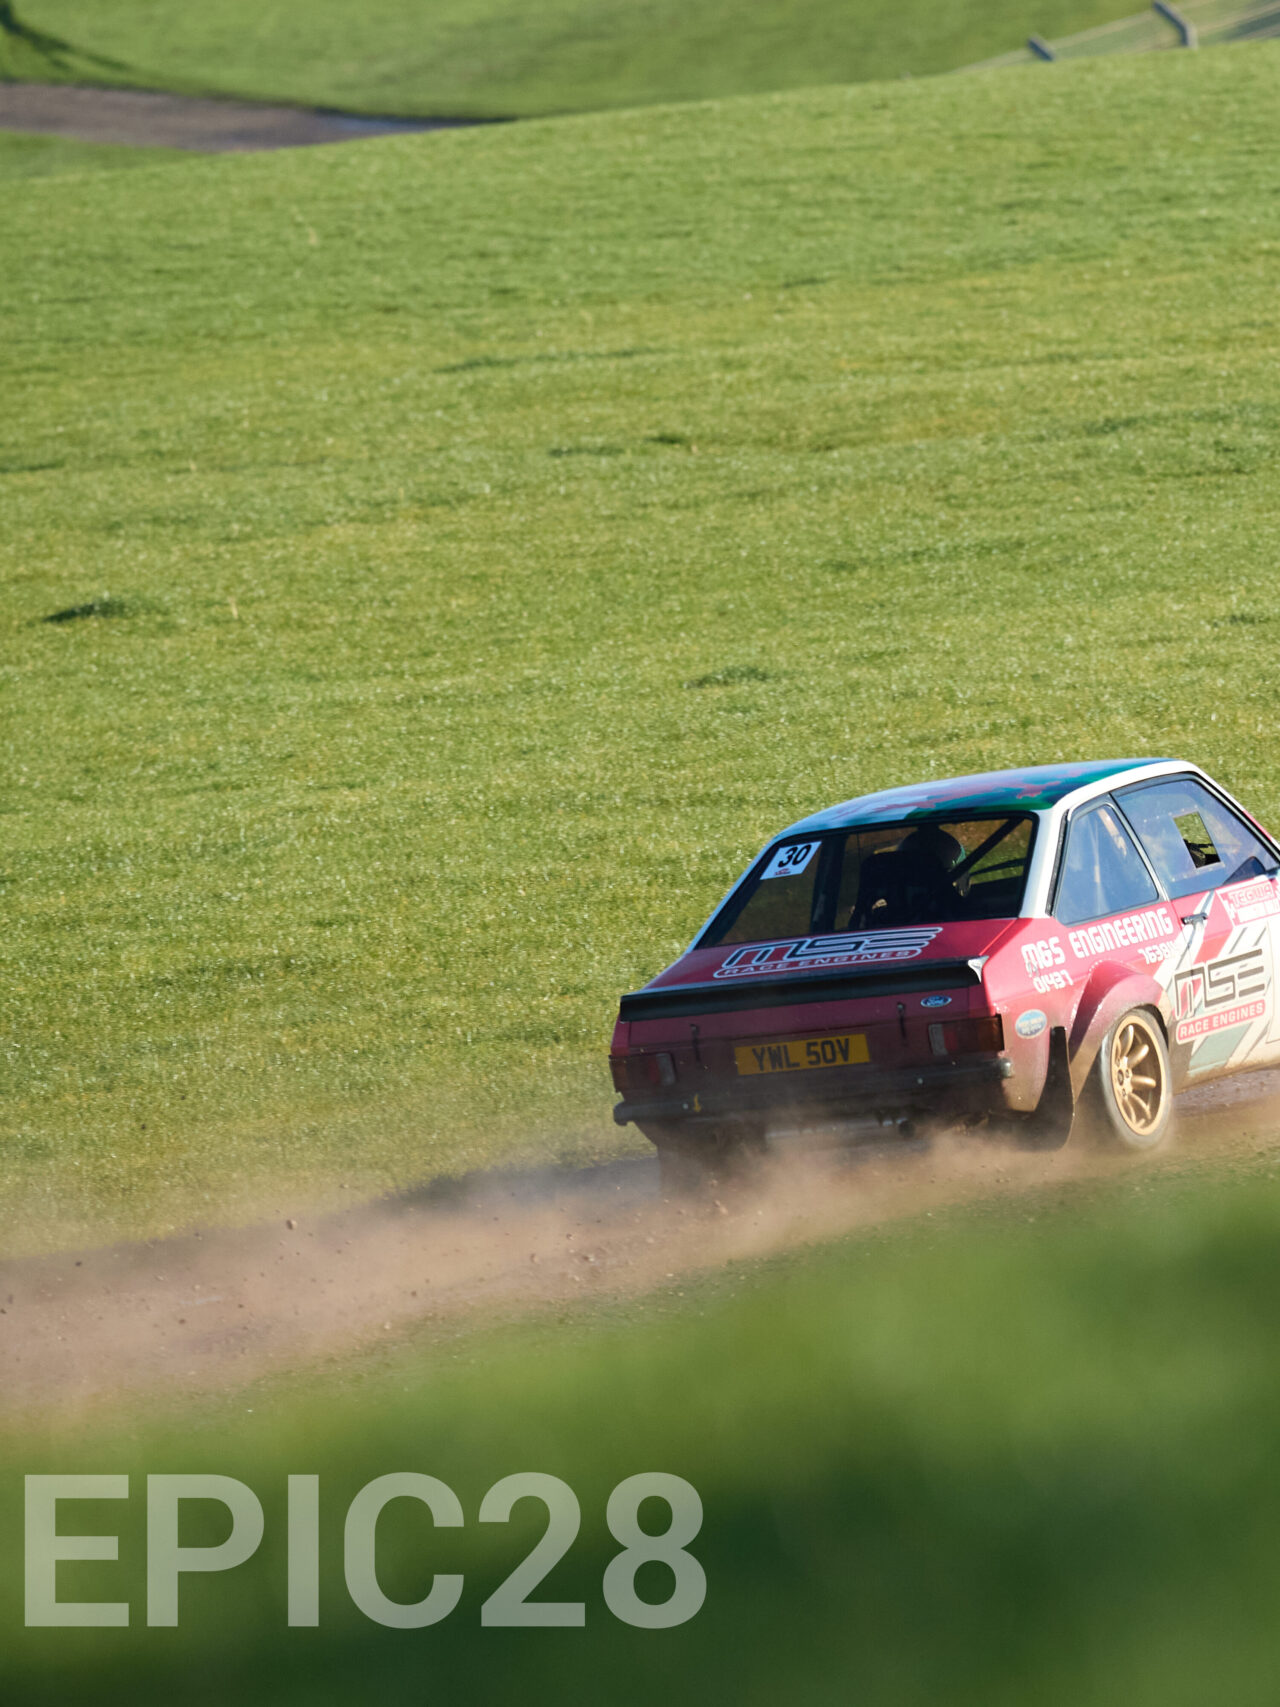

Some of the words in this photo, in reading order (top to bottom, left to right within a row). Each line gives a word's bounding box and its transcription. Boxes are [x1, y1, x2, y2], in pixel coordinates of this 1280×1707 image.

[778, 844, 812, 868] 30
[1068, 908, 1174, 959] ENGINEERING
[724, 962, 788, 976] RACE
[799, 950, 911, 966] ENGINES
[1033, 969, 1073, 994] 01437
[1180, 1019, 1209, 1039] RACE
[1212, 1002, 1264, 1028] ENGINES
[752, 1044, 800, 1072] YWL
[805, 1038, 850, 1066] 50V
